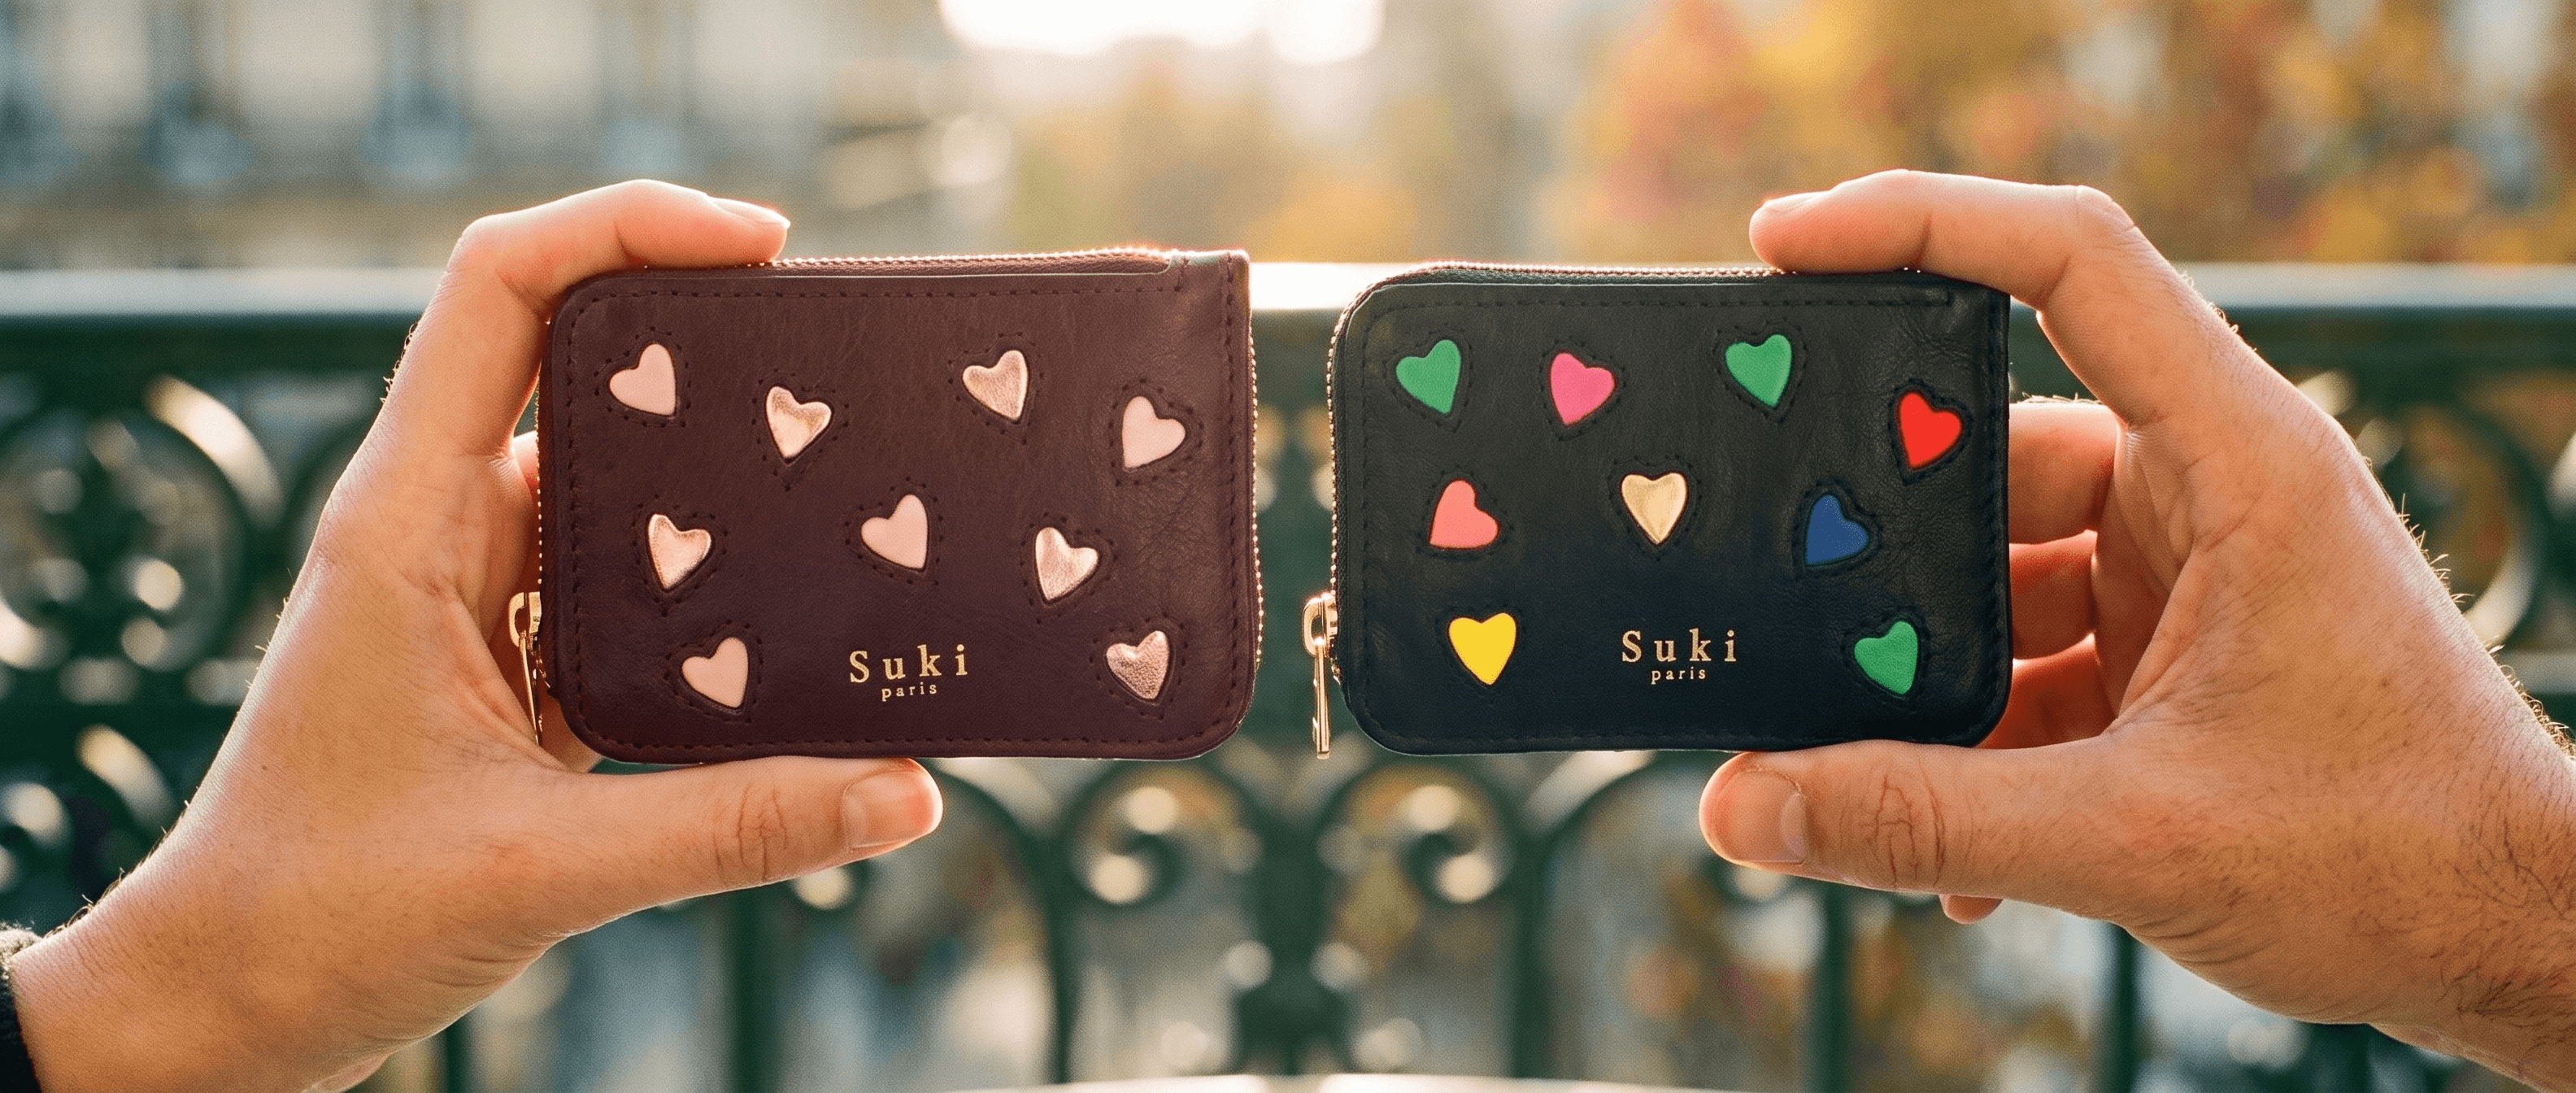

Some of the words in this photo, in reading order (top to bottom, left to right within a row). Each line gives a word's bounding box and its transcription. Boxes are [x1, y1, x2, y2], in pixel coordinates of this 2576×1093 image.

[1621, 628, 1738, 663] Suki
[849, 643, 968, 683] Suki
[1651, 666, 1707, 686] paris
[881, 681, 938, 702] paris
